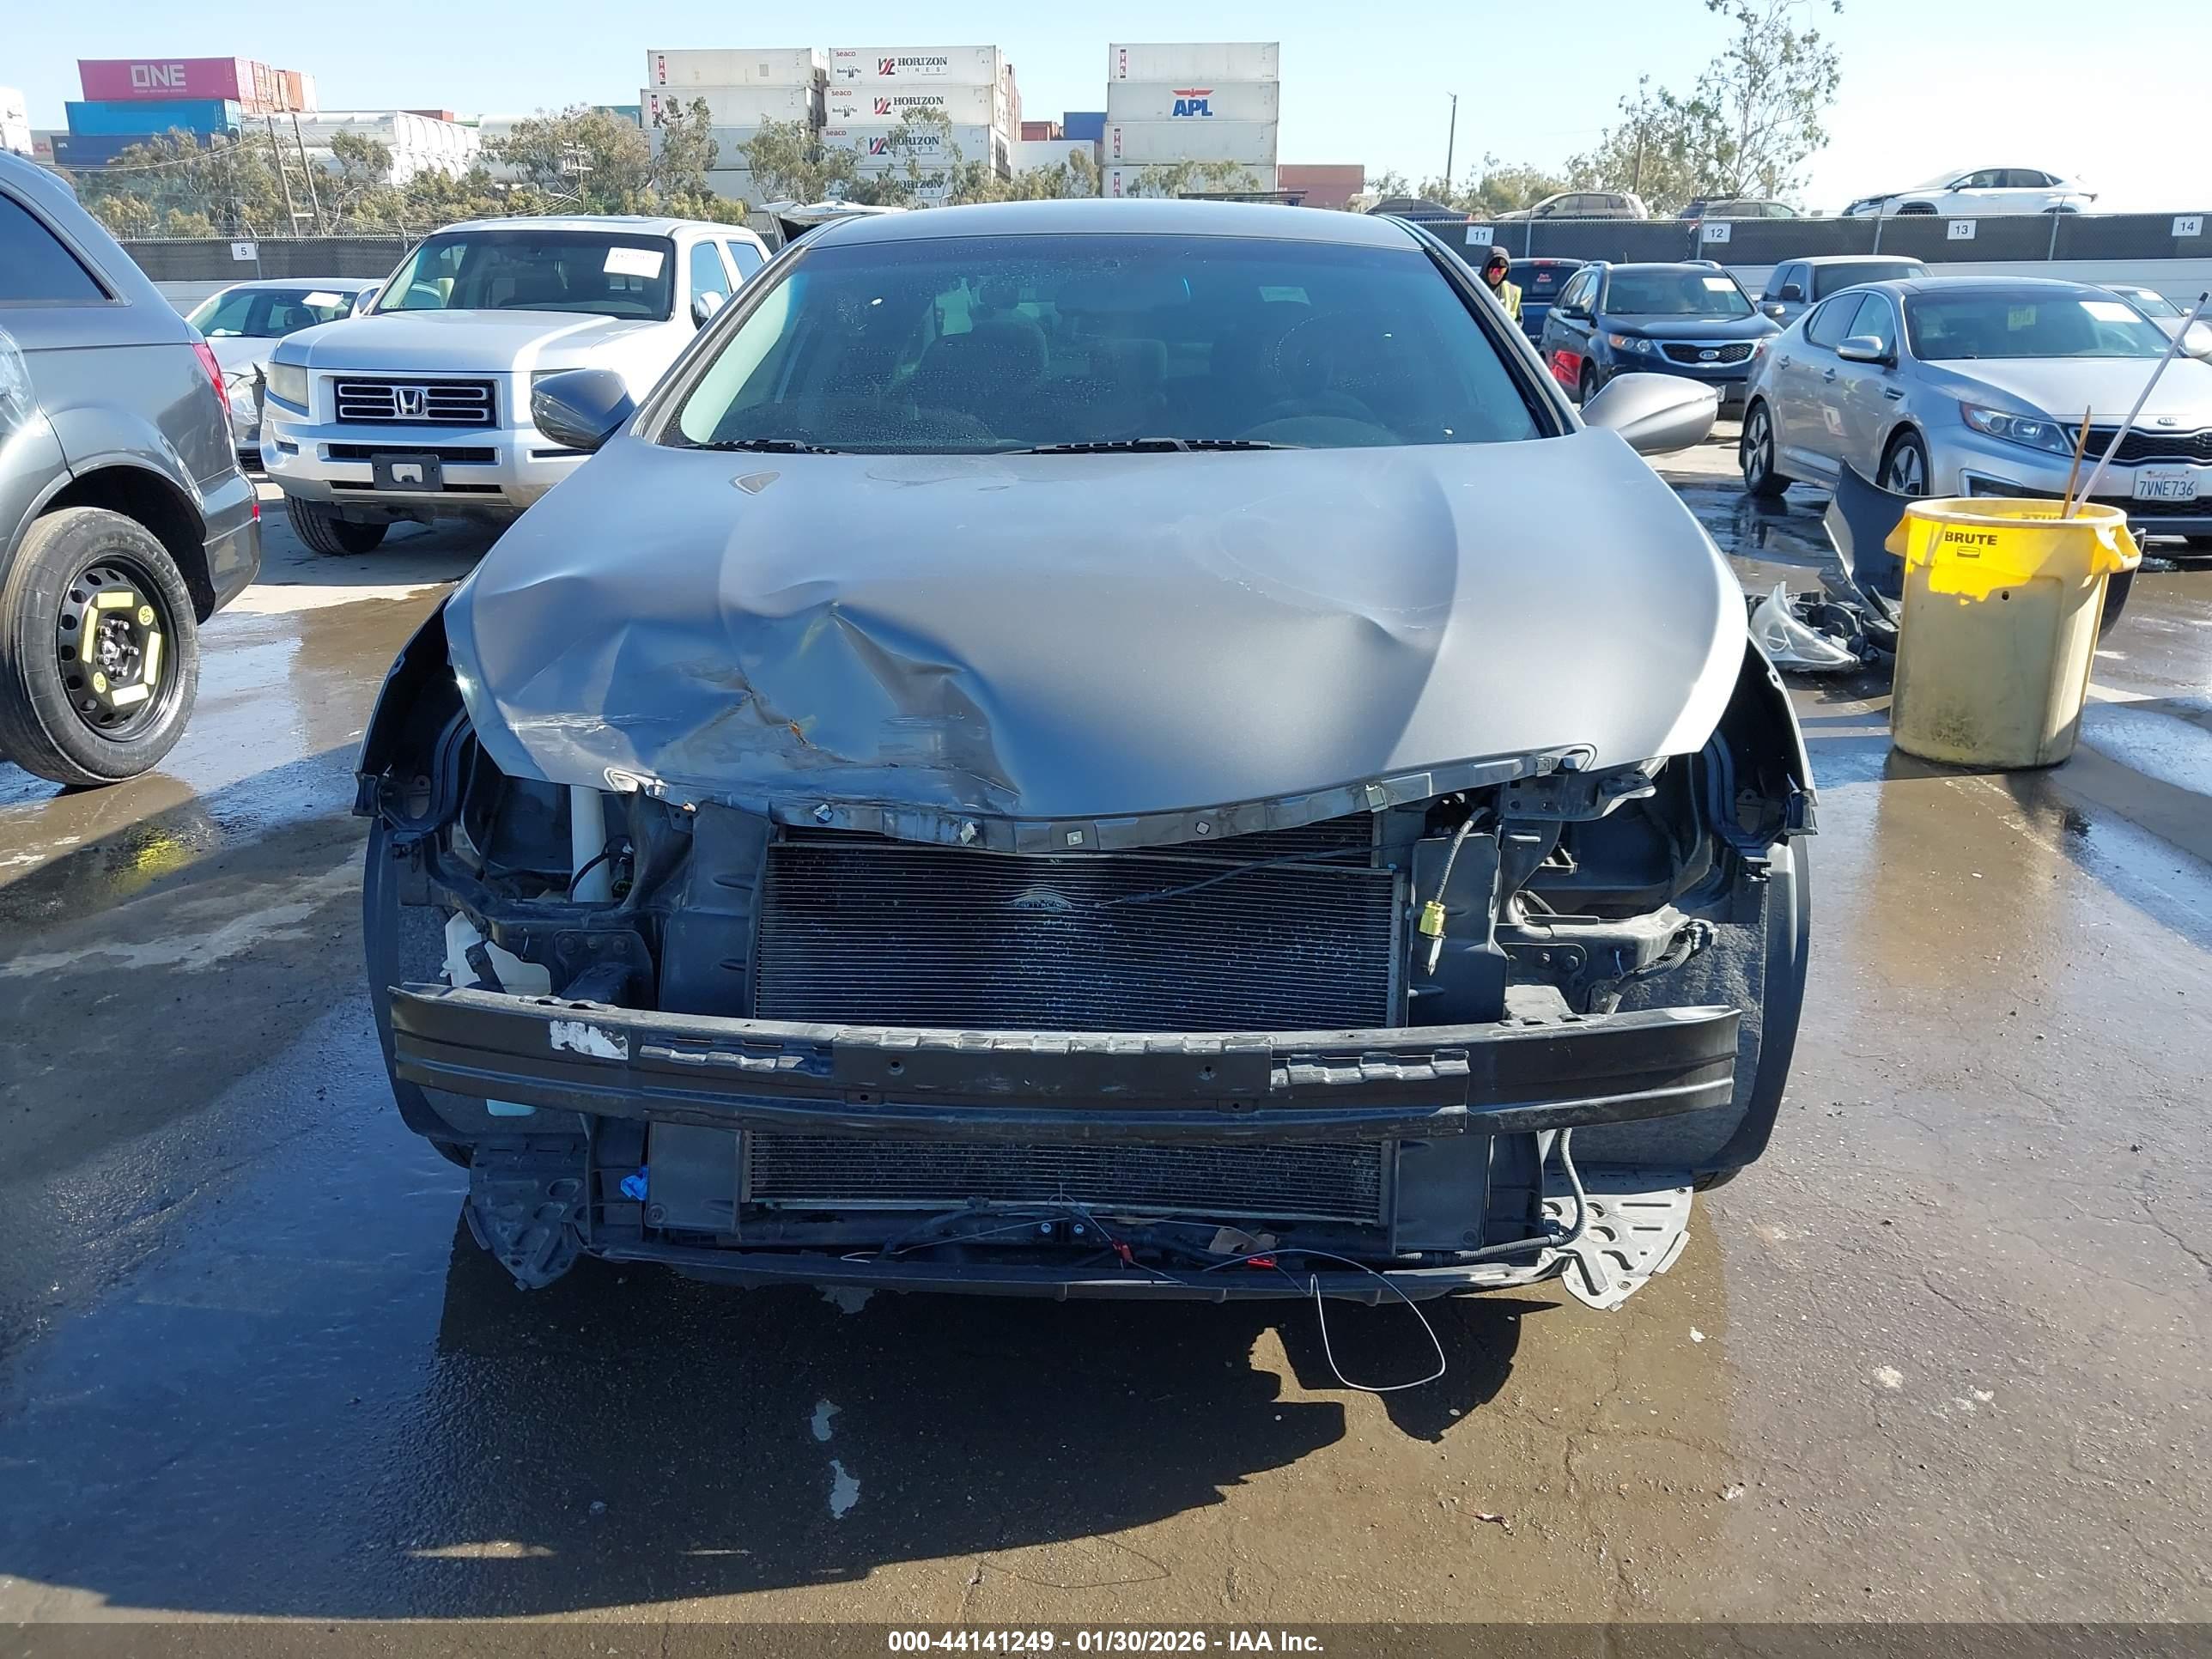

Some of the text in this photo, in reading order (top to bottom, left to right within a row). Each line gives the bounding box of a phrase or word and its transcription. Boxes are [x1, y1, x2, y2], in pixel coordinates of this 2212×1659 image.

[897, 57, 948, 66] HORIZON
[131, 64, 186, 87] ONE
[893, 96, 944, 106] HORIZON
[1172, 99, 1213, 117] APL
[1955, 225, 1969, 235] 13
[2181, 222, 2195, 232] 14
[1474, 231, 1487, 241] 11
[1711, 228, 1724, 238] 12
[240, 246, 247, 256] 5
[2139, 481, 2195, 496] 7VNE736
[1944, 532, 1998, 546] BRUTE
[141, 608, 151, 623] 50
